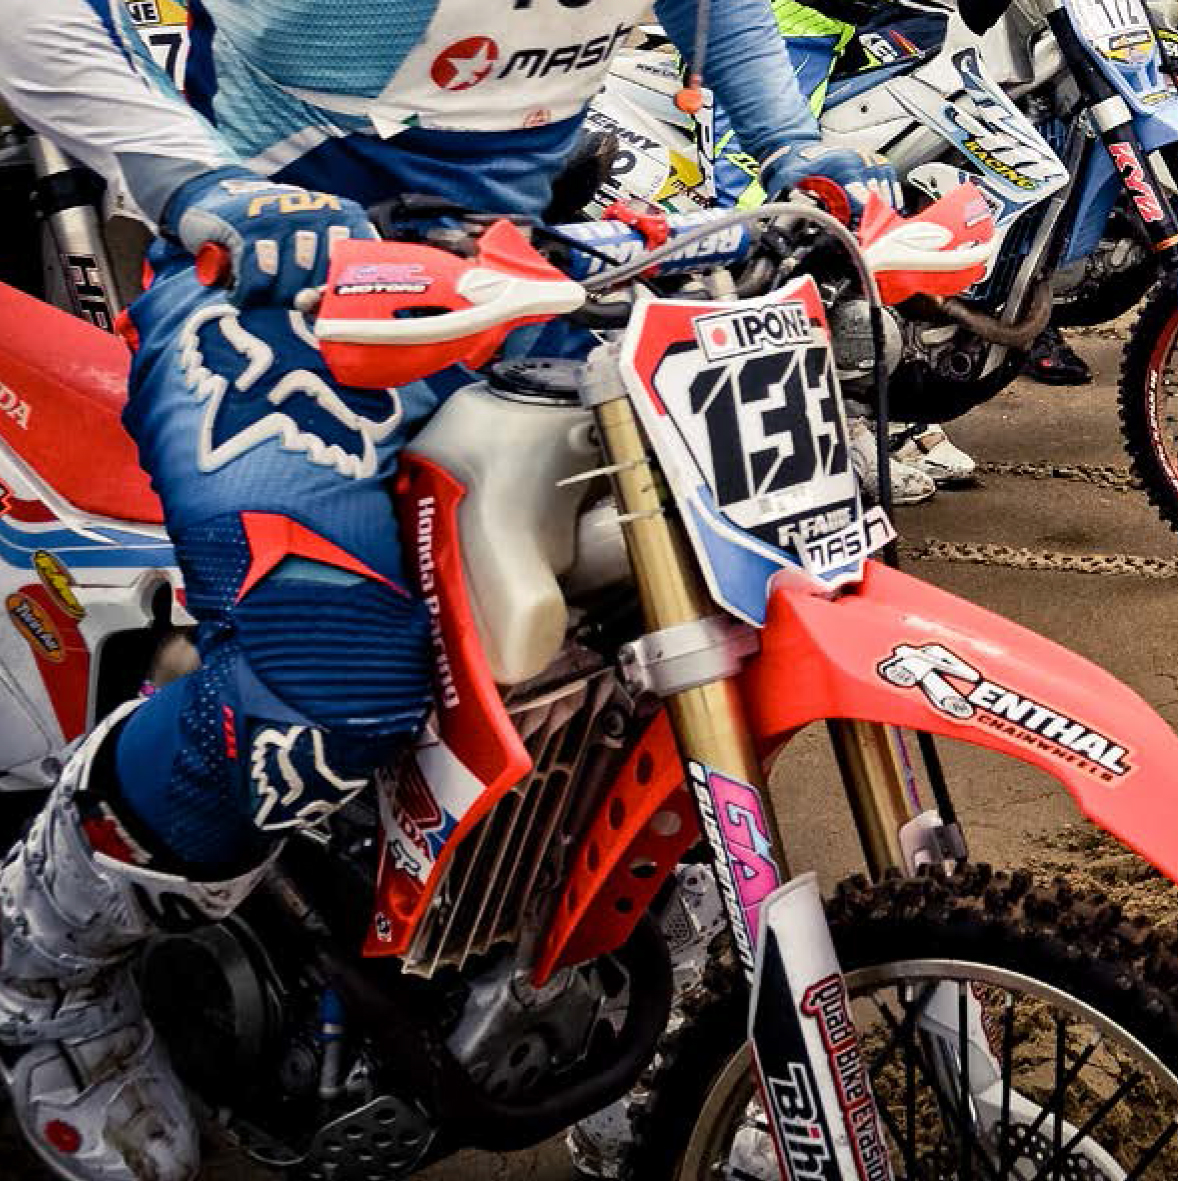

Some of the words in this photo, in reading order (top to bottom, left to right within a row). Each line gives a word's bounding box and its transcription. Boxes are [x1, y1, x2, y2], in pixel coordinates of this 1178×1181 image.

[731, 306, 809, 349] IPONE
[688, 348, 850, 509] 133
[416, 496, 437, 592] Honda
[875, 642, 1133, 777] RENTHAL
[768, 1061, 832, 1181] Bih
